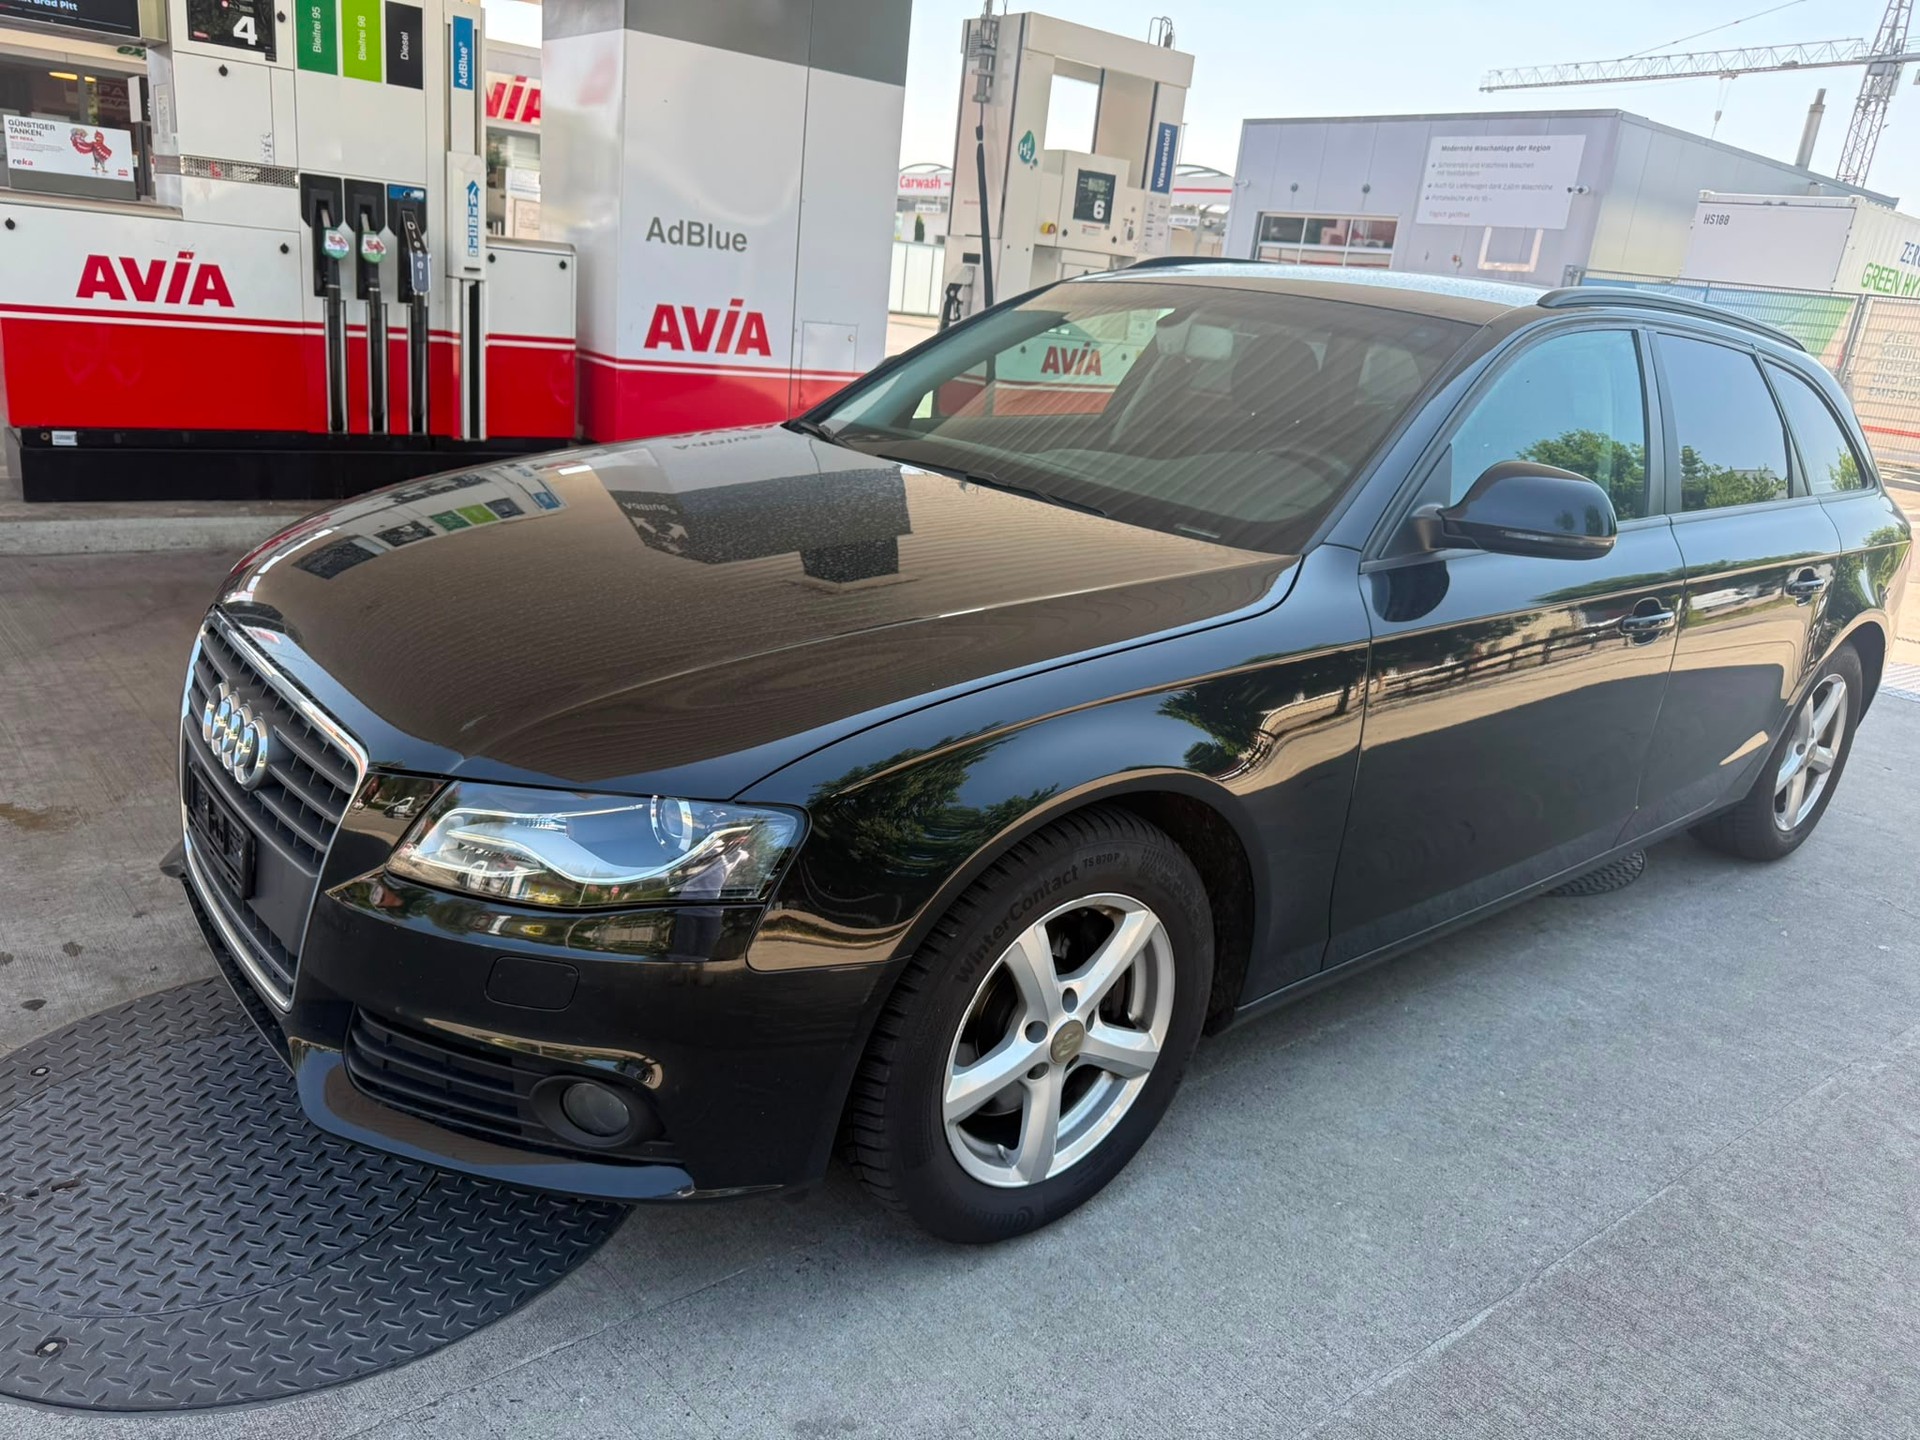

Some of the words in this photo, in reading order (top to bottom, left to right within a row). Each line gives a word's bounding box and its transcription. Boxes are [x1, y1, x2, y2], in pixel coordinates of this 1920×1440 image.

[59, 0, 79, 11] Pitt
[311, 6, 321, 19] 95
[233, 16, 258, 45] 4
[357, 15, 366, 27] 98
[312, 21, 322, 53] Bleifrei
[358, 28, 367, 61] Bleifrei
[400, 31, 409, 61] Diesel
[8, 119, 56, 132] GÜNSTIGER
[9, 126, 45, 137] TANKEN.
[1156, 128, 1172, 188] Wasserstoff
[1474, 145, 1515, 153] Waschanlage
[1516, 144, 1527, 152] der
[1528, 144, 1552, 153] Region
[12, 158, 33, 166] reka
[900, 175, 942, 189] Carwash
[1093, 200, 1106, 220] 6
[1703, 213, 1731, 226] HS188
[646, 216, 748, 253] AdBlue
[76, 250, 236, 309] AVIA
[1861, 262, 1904, 296] GREEN
[1901, 272, 1920, 298] HY
[643, 298, 772, 358] AVIA
[1040, 340, 1103, 377] AVIA
[1868, 386, 1920, 401] EMISSIO
[956, 864, 1079, 984] WinterContact
[1082, 857, 1095, 868] TS
[1096, 854, 1113, 867] 870
